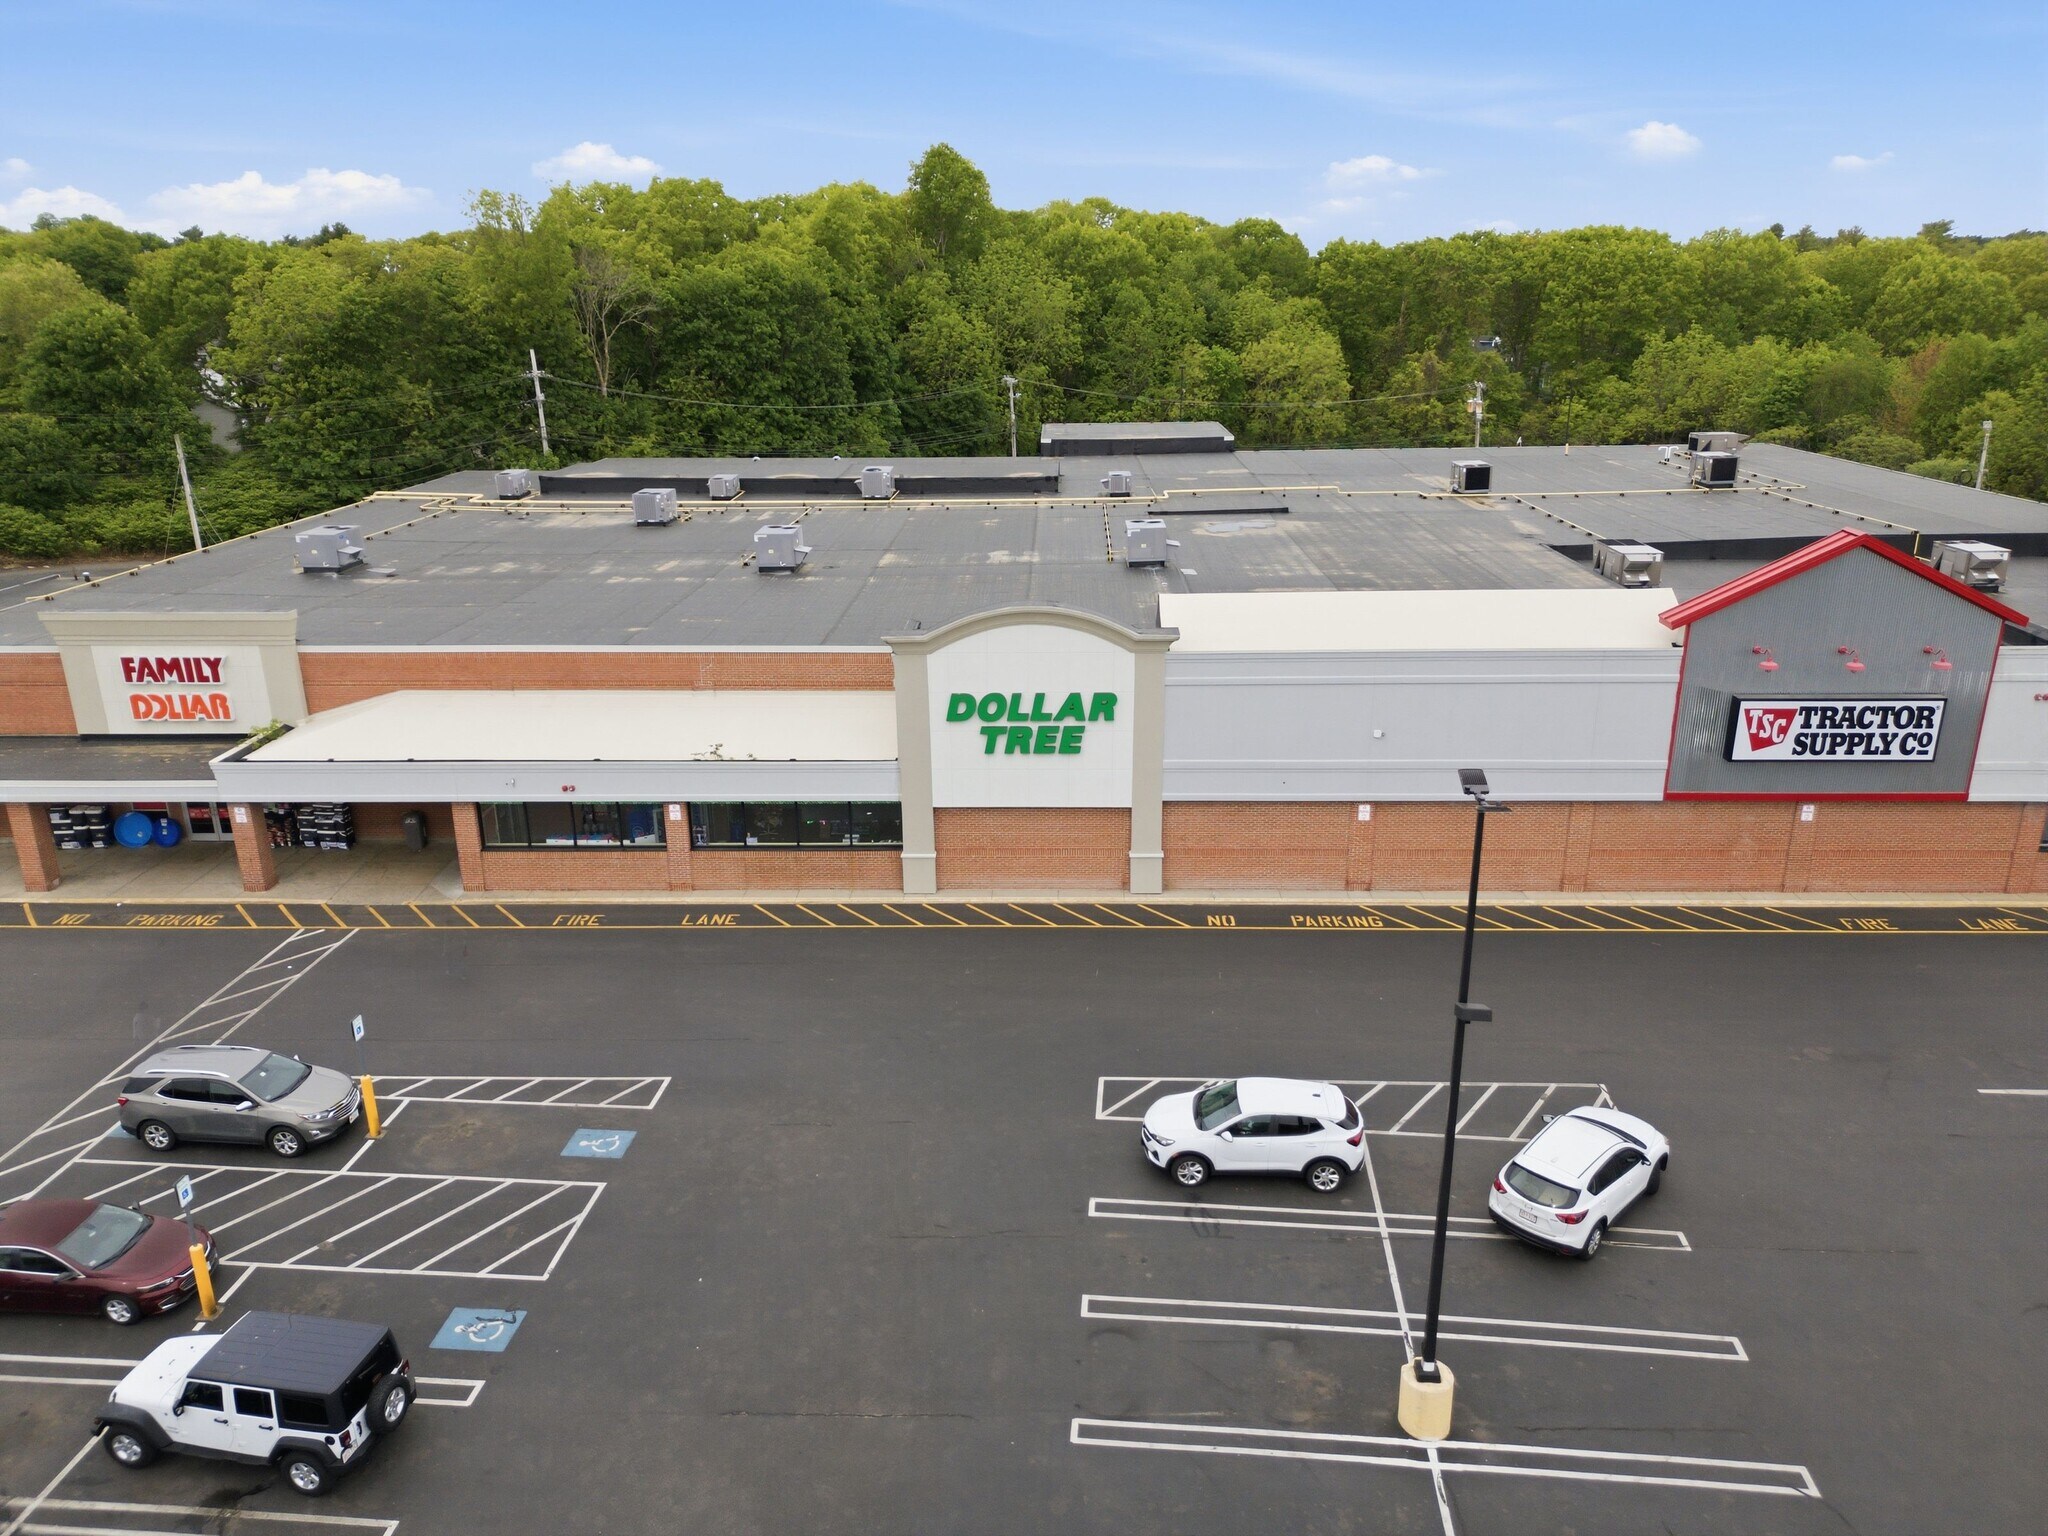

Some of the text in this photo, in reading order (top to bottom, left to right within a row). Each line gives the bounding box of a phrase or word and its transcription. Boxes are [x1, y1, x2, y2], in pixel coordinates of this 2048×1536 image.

[120, 656, 223, 683] FAMILY
[129, 693, 232, 720] DOLLAR
[947, 692, 1118, 722] DOLLAR
[1799, 706, 1936, 730] TRACTOR
[1749, 709, 1787, 744] TSC
[979, 725, 1086, 754] TREE
[1791, 733, 1899, 756] SUPPLY
[52, 913, 224, 926] NO PARKING
[552, 914, 741, 926] FIRE LANE
[1207, 914, 1384, 928] NO PARKING
[1838, 918, 2030, 931] FIRE LANE
